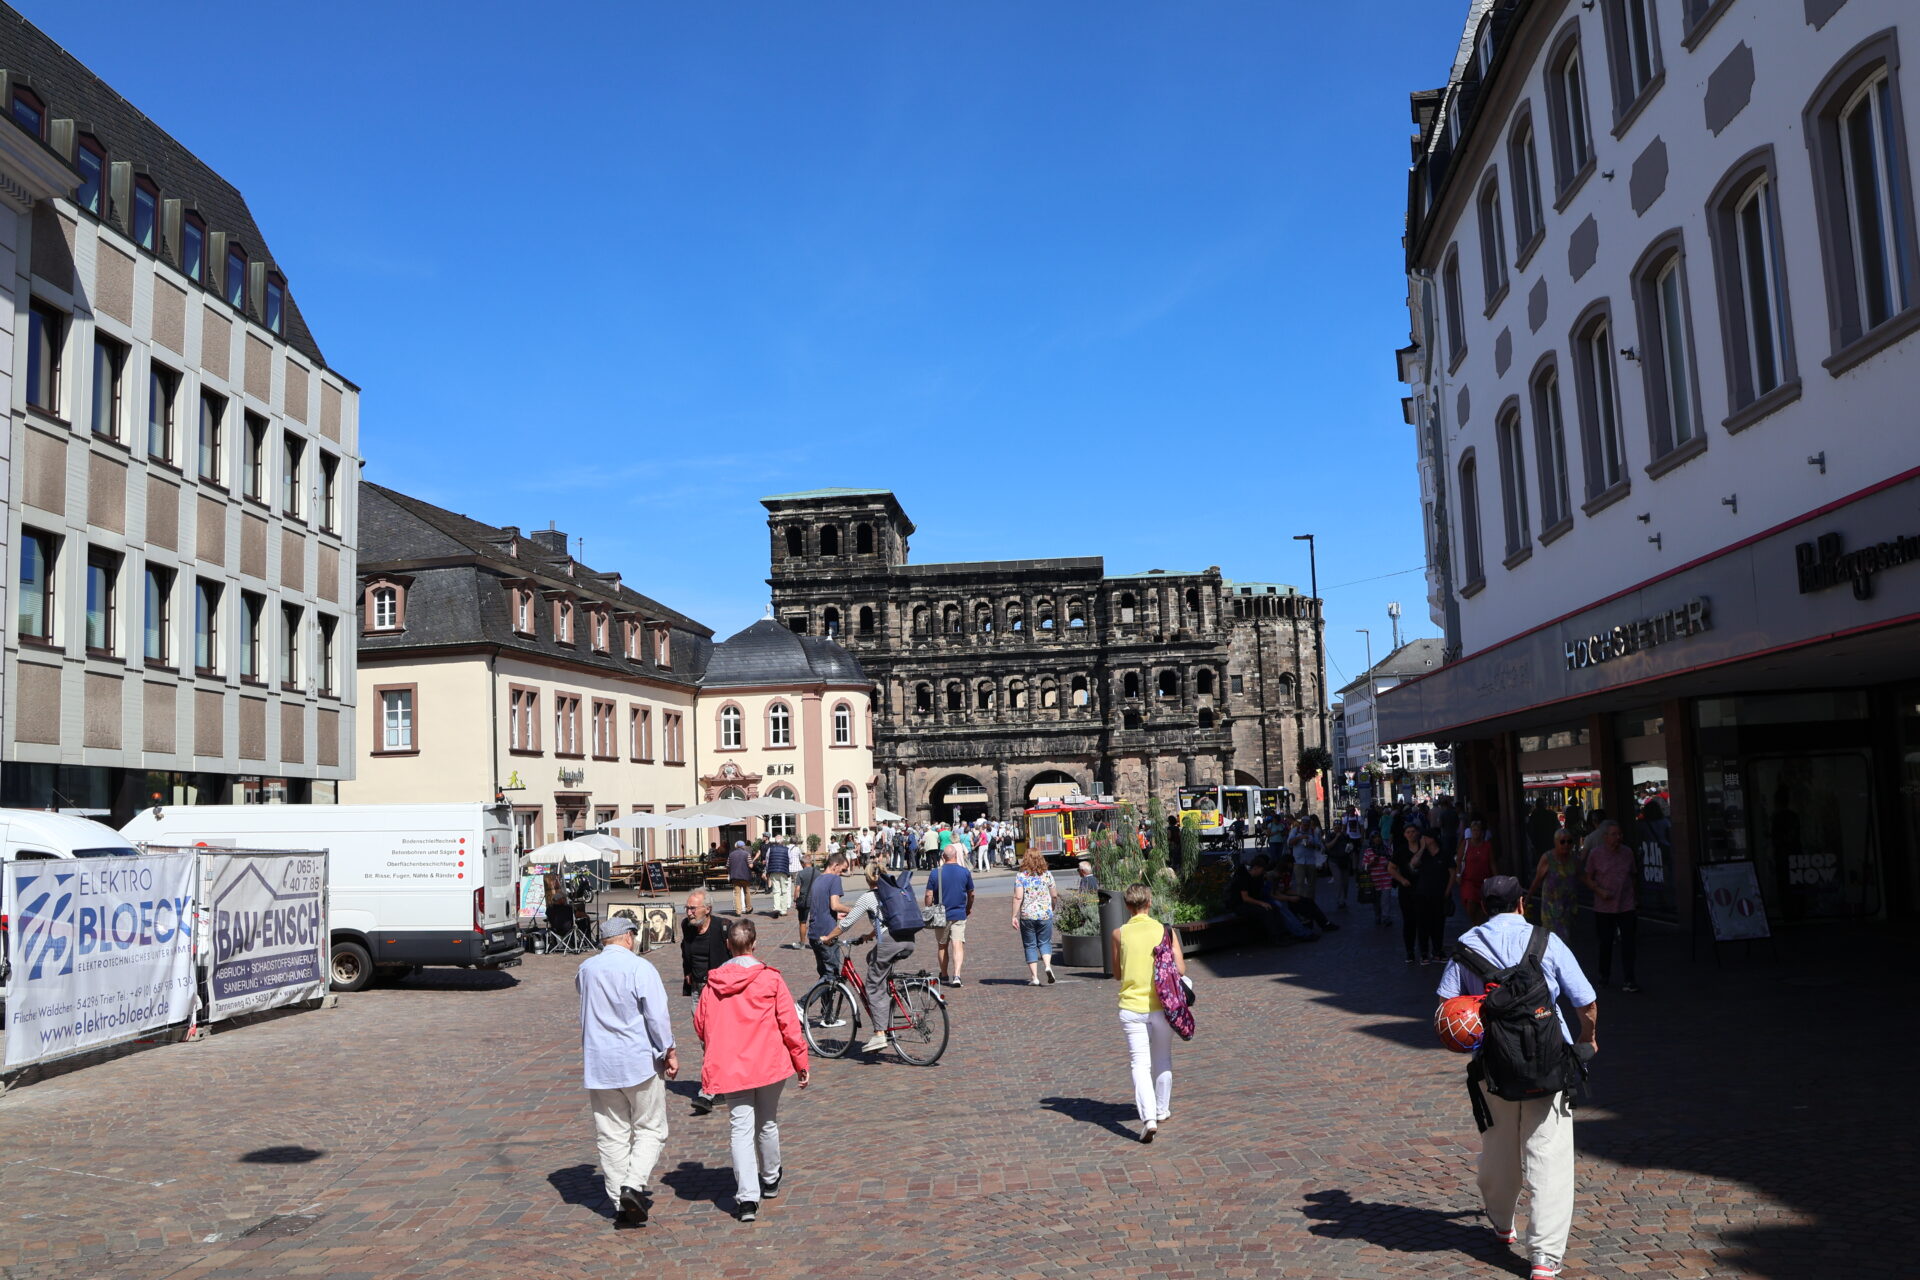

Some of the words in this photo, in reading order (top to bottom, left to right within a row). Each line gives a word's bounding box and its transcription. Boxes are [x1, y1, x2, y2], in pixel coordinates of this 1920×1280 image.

[1564, 597, 1708, 670] HOCHSTETTER
[297, 859, 319, 874] 0651-
[1788, 853, 1837, 869] SHOP
[80, 868, 153, 896] ELEKTRO
[1643, 865, 1664, 883] OPEN
[1789, 867, 1838, 885] NOW
[289, 877, 300, 892] 40
[302, 877, 308, 891] 7
[309, 876, 320, 890] 85
[78, 895, 192, 955] BLOECK
[217, 899, 320, 963] BAU-ENSCH
[216, 965, 246, 980] ABBRUCH
[223, 977, 259, 994] SANIERUNG
[100, 993, 116, 1005] Trier
[39, 995, 169, 1044] www.elektro-bloeck.de
